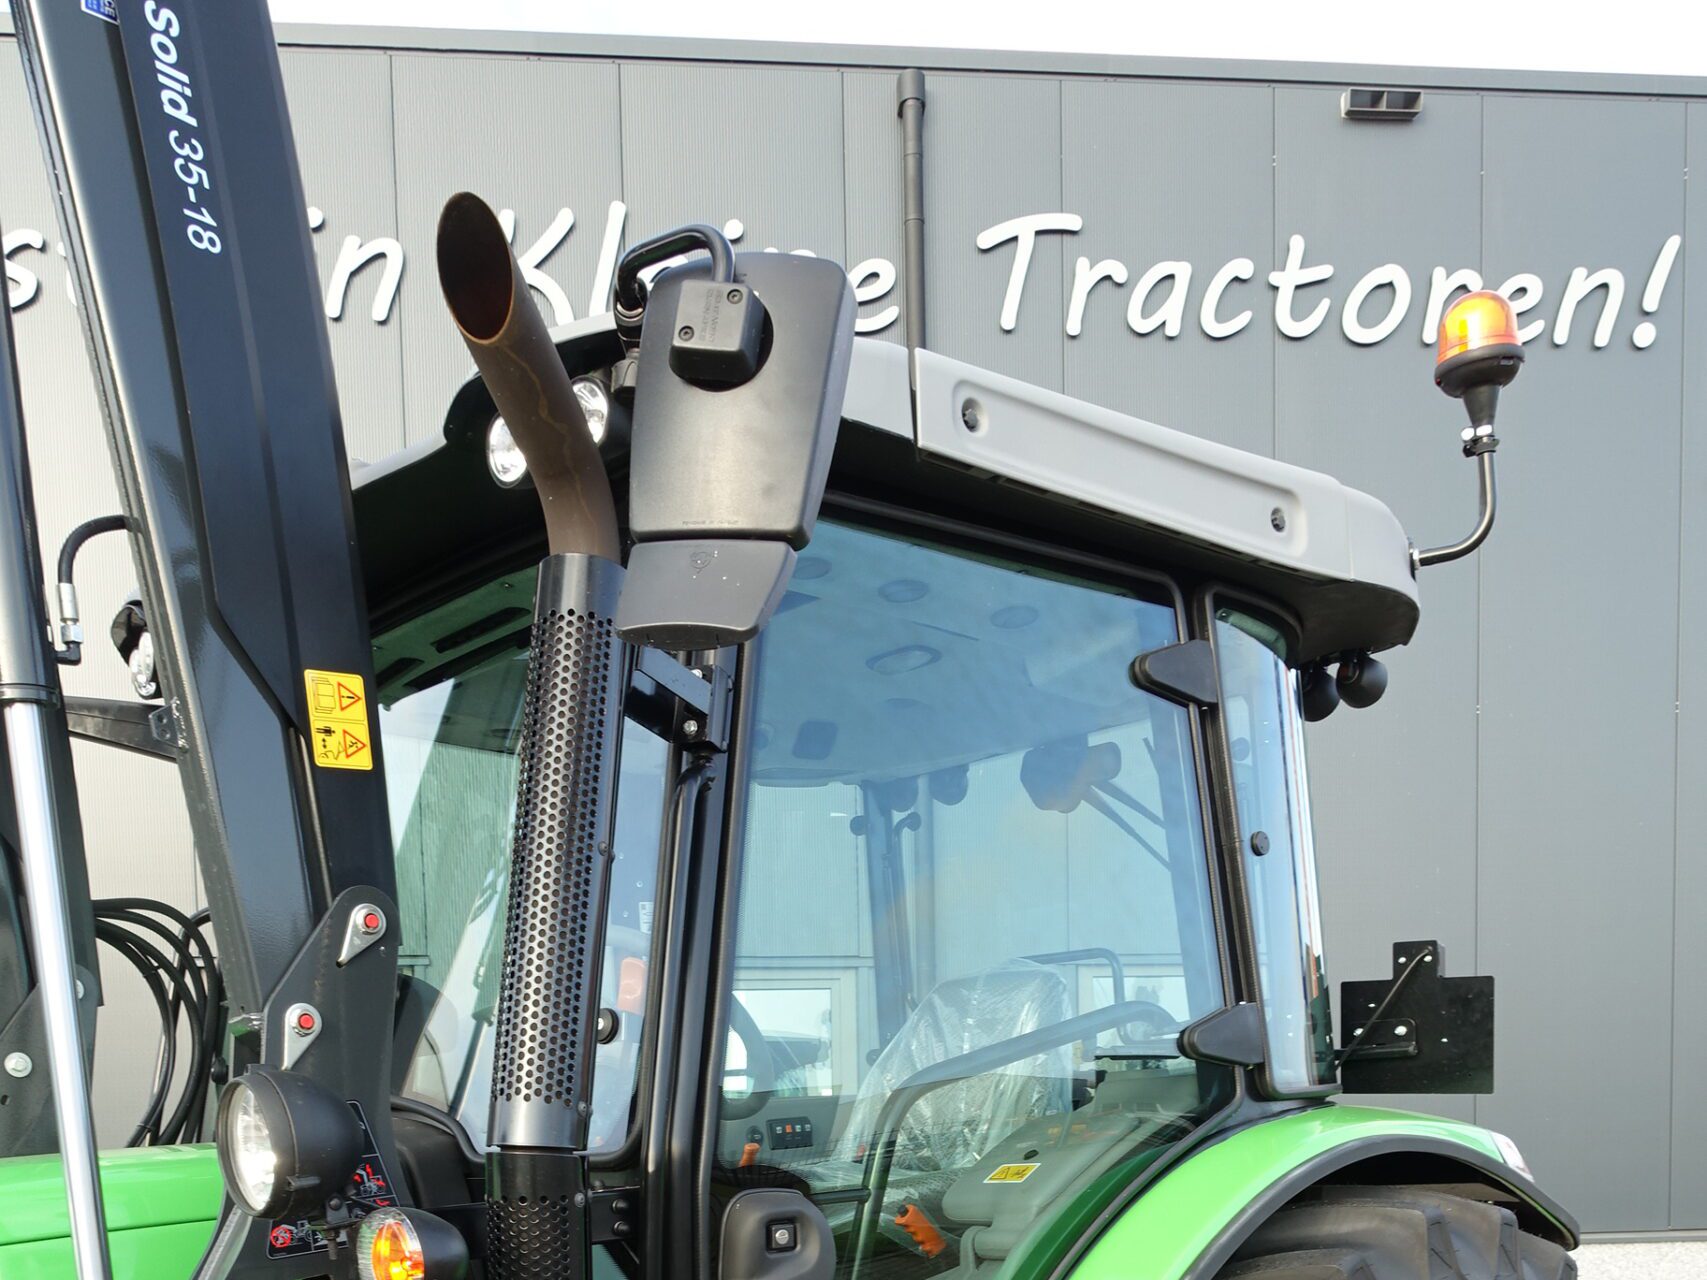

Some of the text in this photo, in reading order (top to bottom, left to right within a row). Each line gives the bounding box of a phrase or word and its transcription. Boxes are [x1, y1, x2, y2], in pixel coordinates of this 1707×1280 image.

[144, 0, 222, 254] Solid 35-18
[976, 212, 1681, 348] Tractoren!
